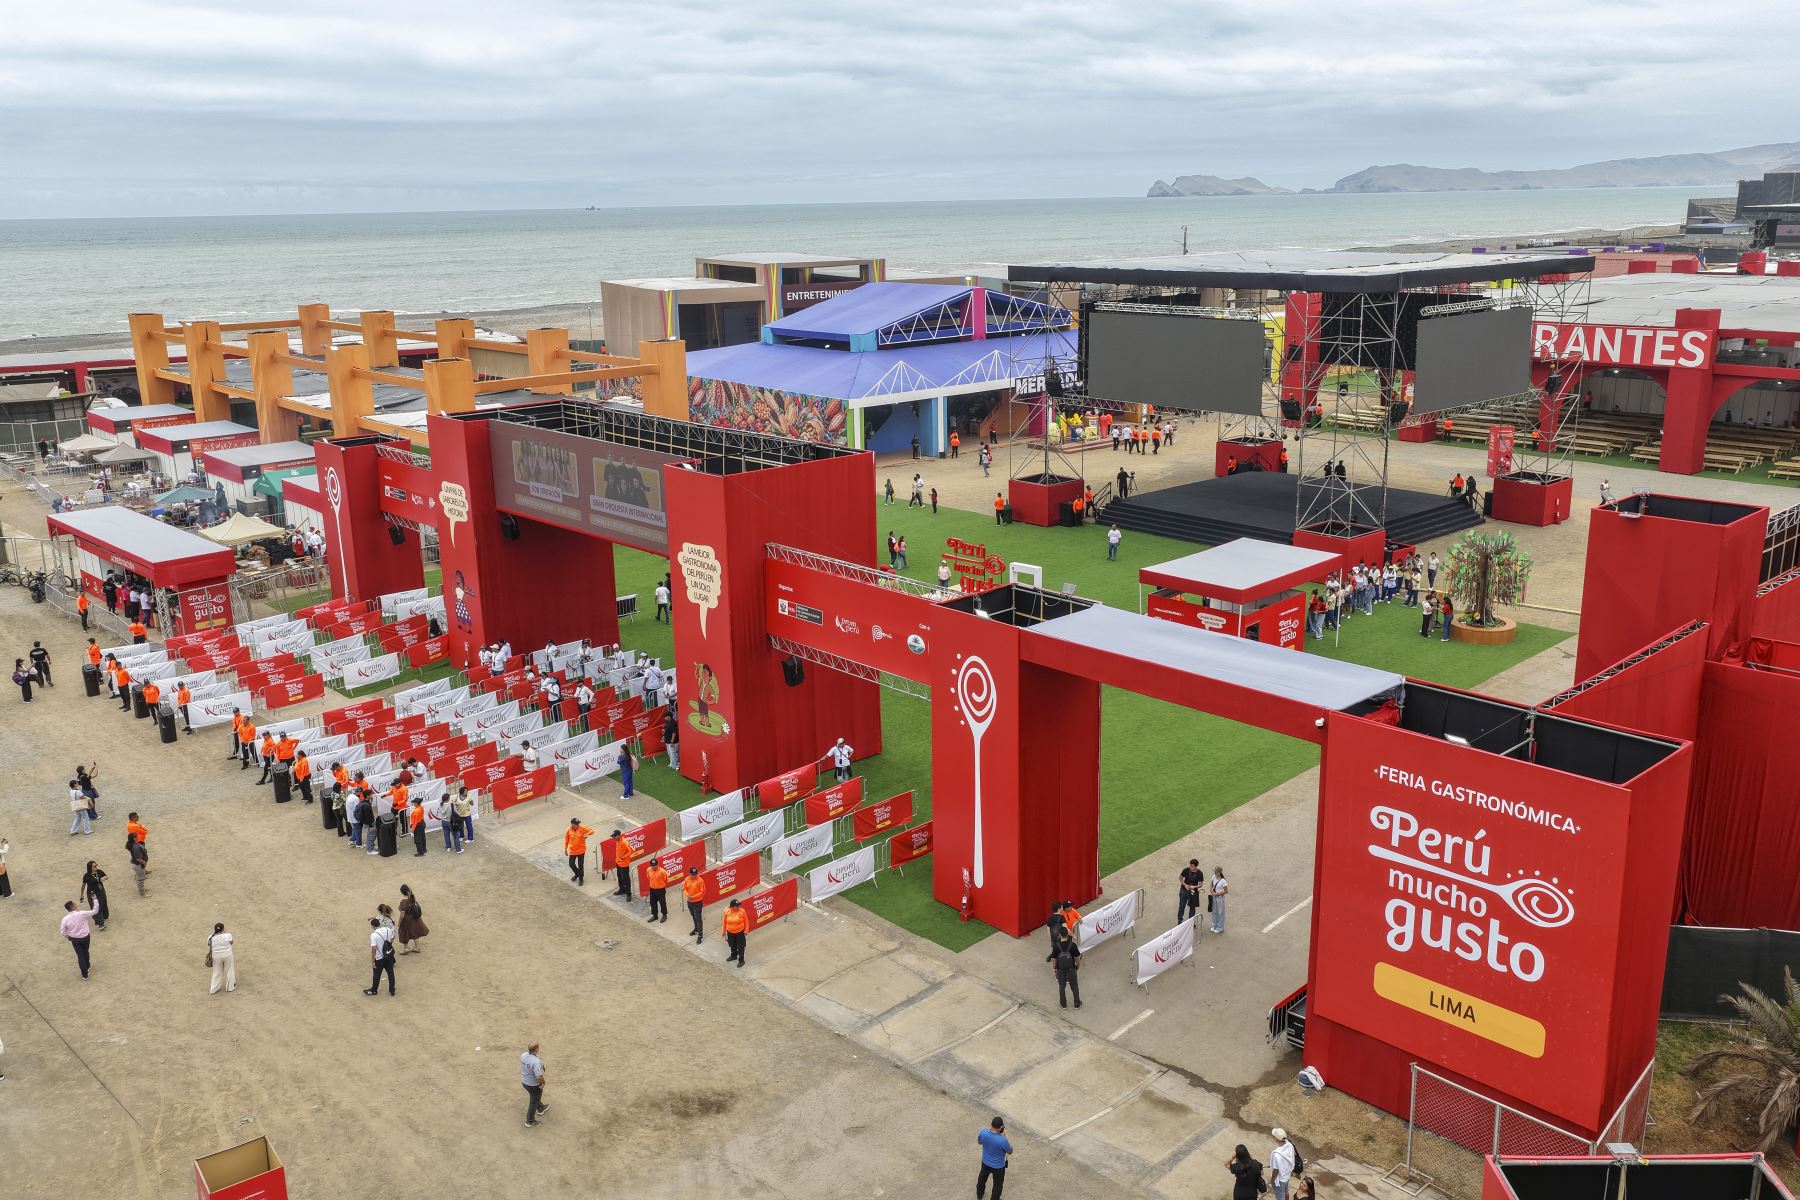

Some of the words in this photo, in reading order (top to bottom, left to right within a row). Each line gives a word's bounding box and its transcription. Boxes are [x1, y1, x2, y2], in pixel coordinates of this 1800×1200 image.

[592, 499, 604, 508] GRAN
[605, 501, 628, 514] ORQUESTA
[628, 507, 664, 523] INTERNACIONAL
[694, 548, 710, 560] MEJOR
[946, 537, 986, 559] Perú
[686, 568, 696, 577] DEL
[694, 592, 710, 603] LUGAR
[1379, 765, 1426, 791] FERIA
[1432, 780, 1576, 834] GASTRONÓMICA
[706, 804, 726, 819] prom
[712, 809, 730, 822] perú
[752, 828, 770, 842] perú
[1370, 805, 1491, 876] Perú
[835, 860, 856, 878] prom
[842, 866, 860, 882] perú
[1388, 868, 1488, 918] mucho
[1385, 898, 1545, 983] gusto
[1429, 990, 1476, 1023] LIMA
